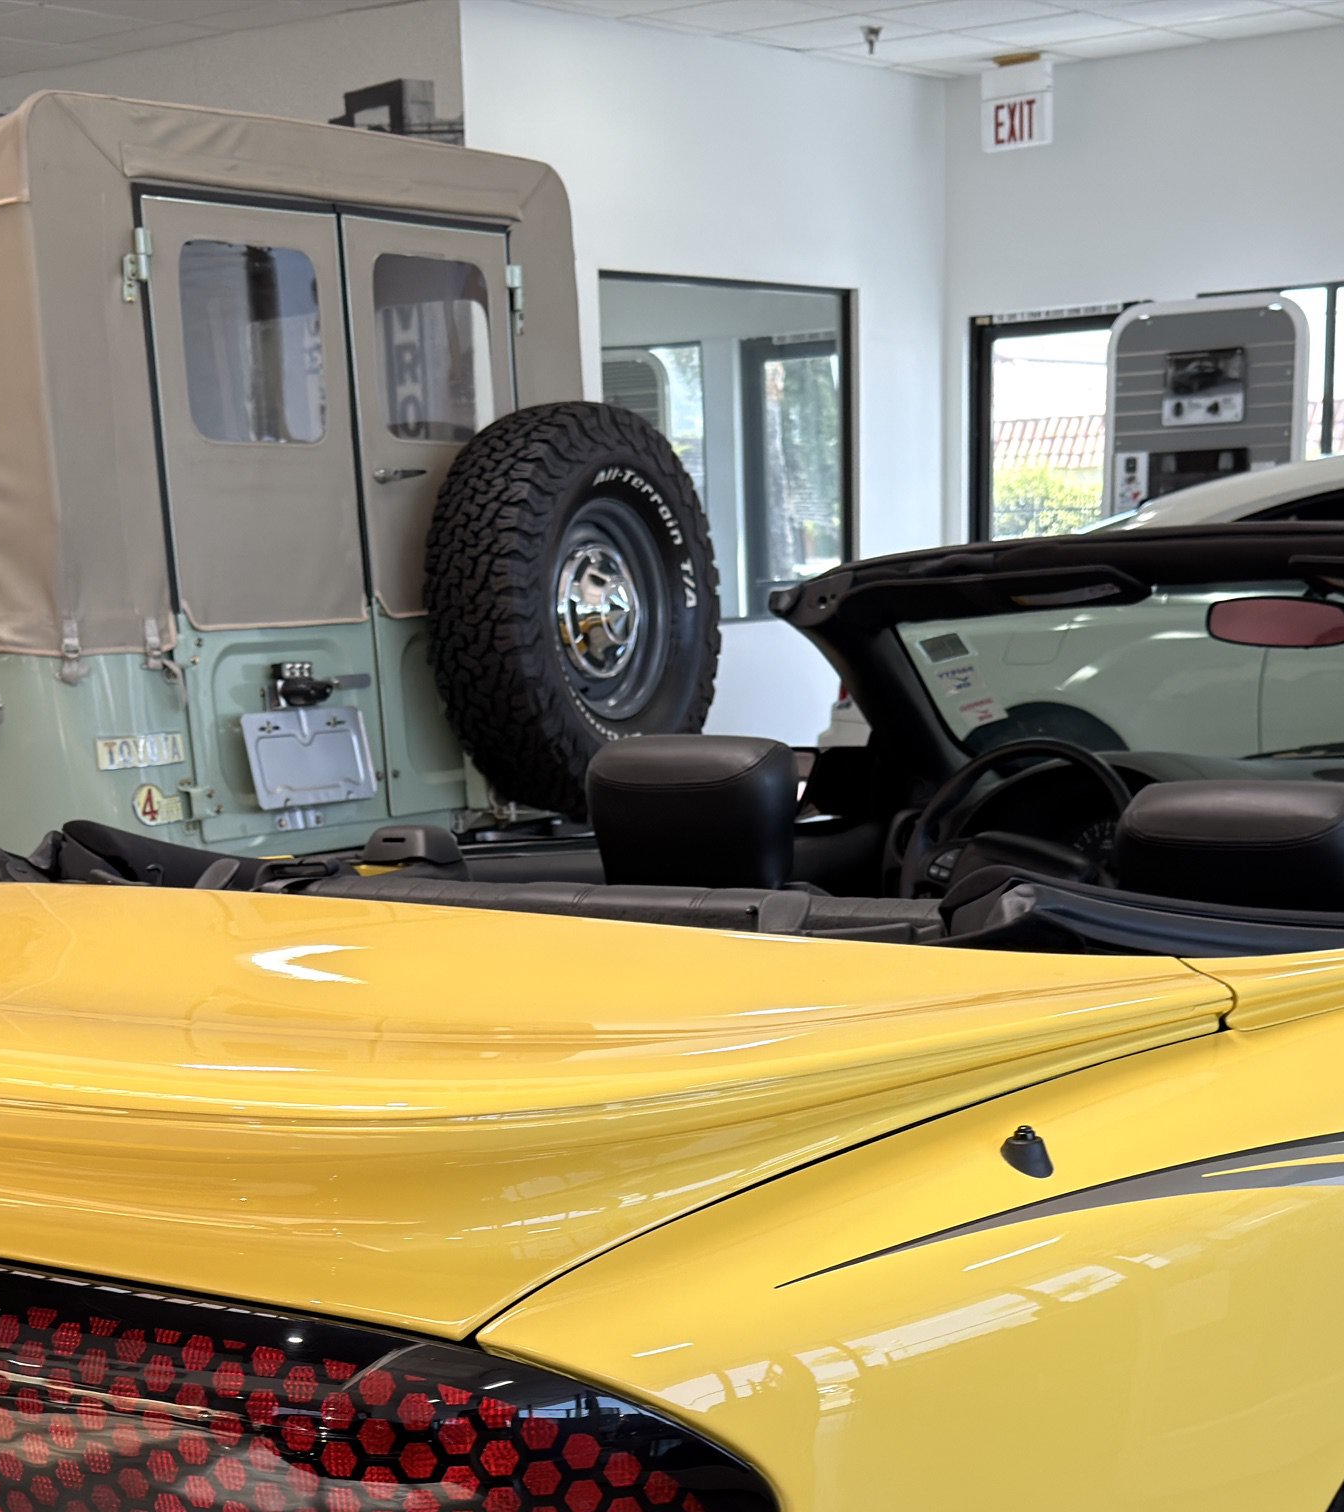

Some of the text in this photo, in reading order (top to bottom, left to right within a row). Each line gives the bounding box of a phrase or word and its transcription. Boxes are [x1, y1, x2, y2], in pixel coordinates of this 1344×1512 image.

[994, 99, 1036, 145] EXIT
[680, 558, 697, 609] T/A
[104, 735, 182, 766] TOYOTA
[141, 787, 159, 822] 4
